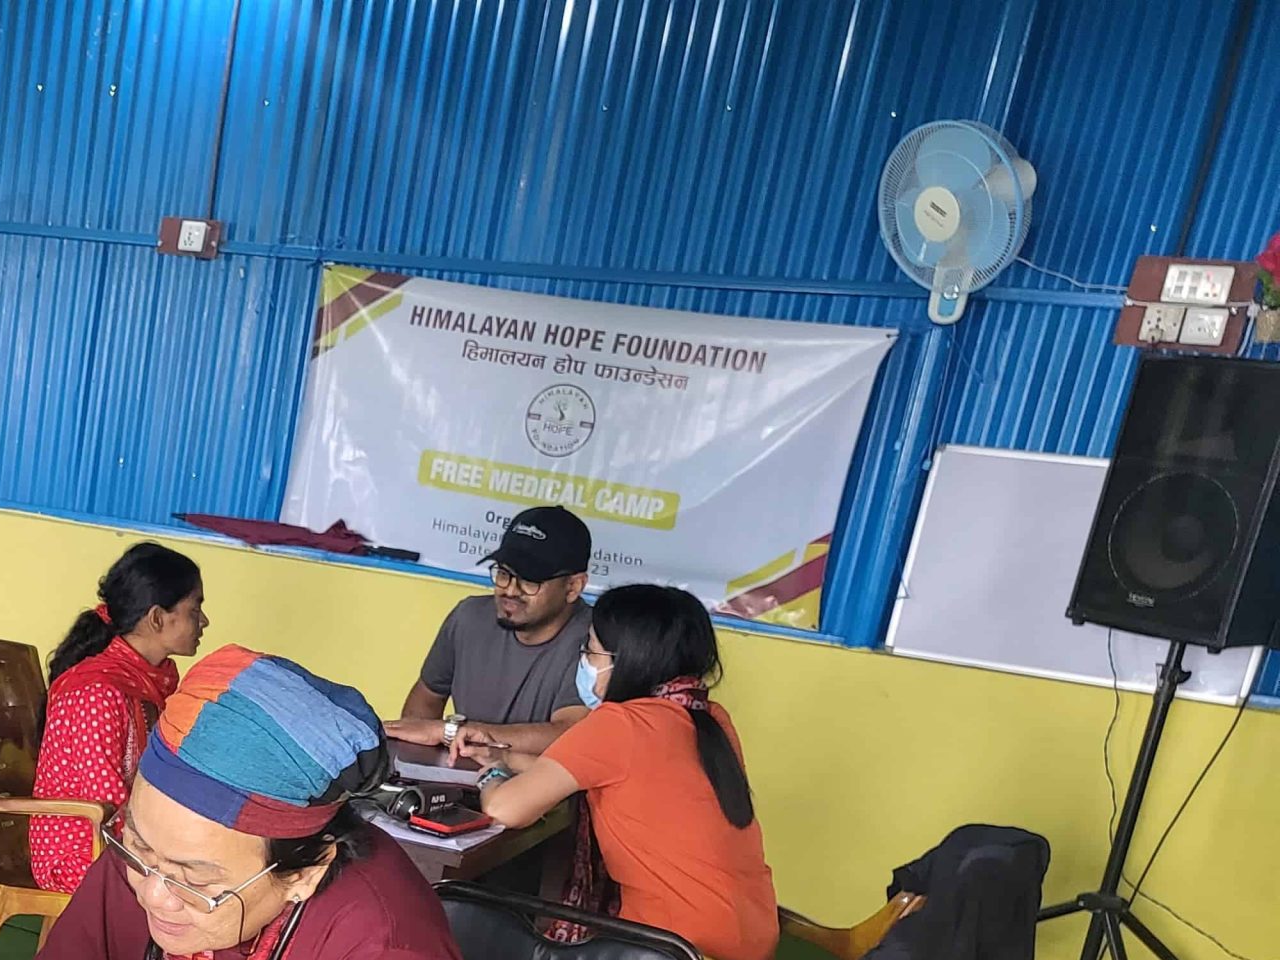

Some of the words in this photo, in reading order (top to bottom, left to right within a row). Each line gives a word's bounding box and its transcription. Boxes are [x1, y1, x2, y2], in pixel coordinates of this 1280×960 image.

[410, 305, 537, 342] HIMALAYAN
[543, 322, 606, 352] HOPE
[613, 333, 768, 374] FOUNDATION
[462, 340, 547, 370] हिमालयन
[553, 354, 588, 376] होप
[543, 422, 574, 436] HOPE
[429, 457, 484, 488] FREE
[488, 468, 588, 508] MEDICAL
[594, 487, 665, 520] CAMP
[485, 511, 511, 530] Org
[593, 548, 643, 567] dation
[591, 563, 609, 577] 23
